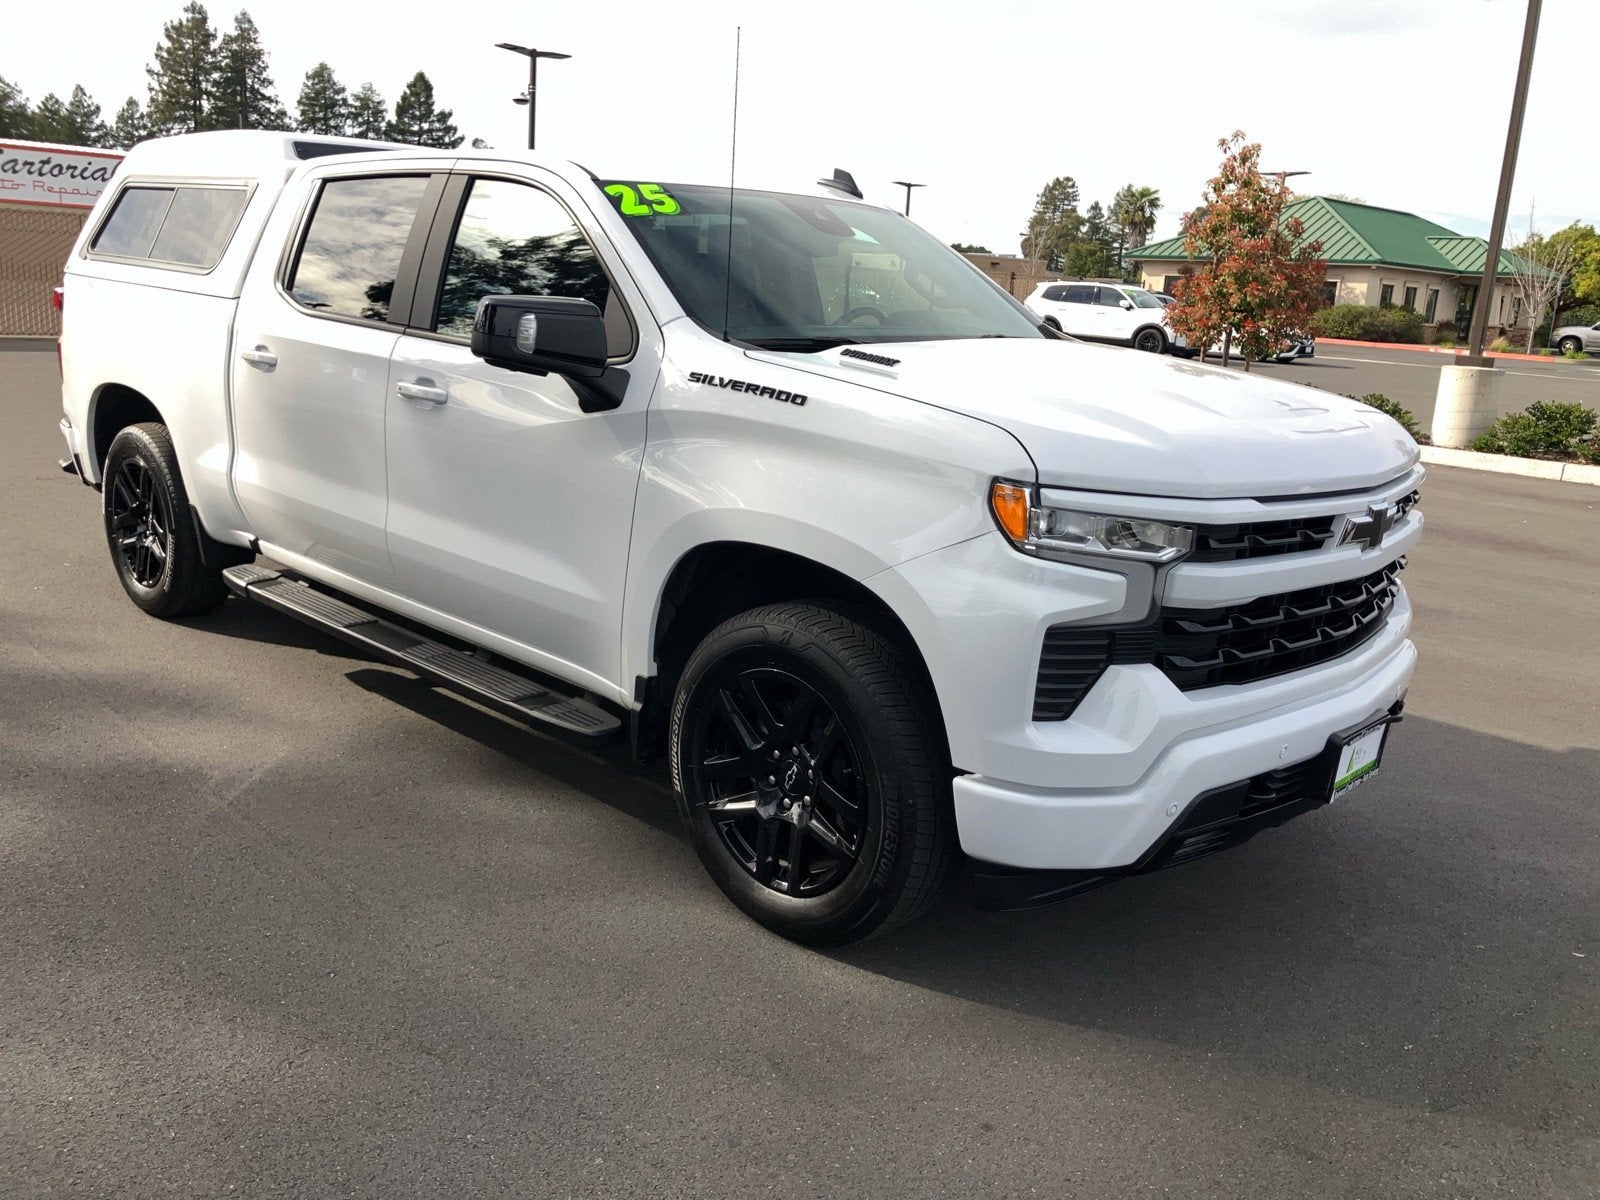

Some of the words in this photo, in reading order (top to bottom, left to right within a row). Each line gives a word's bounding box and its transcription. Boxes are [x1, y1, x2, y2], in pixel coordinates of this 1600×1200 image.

[0, 148, 123, 182] artoria
[603, 184, 680, 215] 25
[840, 348, 901, 367] DURAMAX
[688, 371, 808, 407] SILVERADO
[671, 688, 687, 794] BRIDGESTONE
